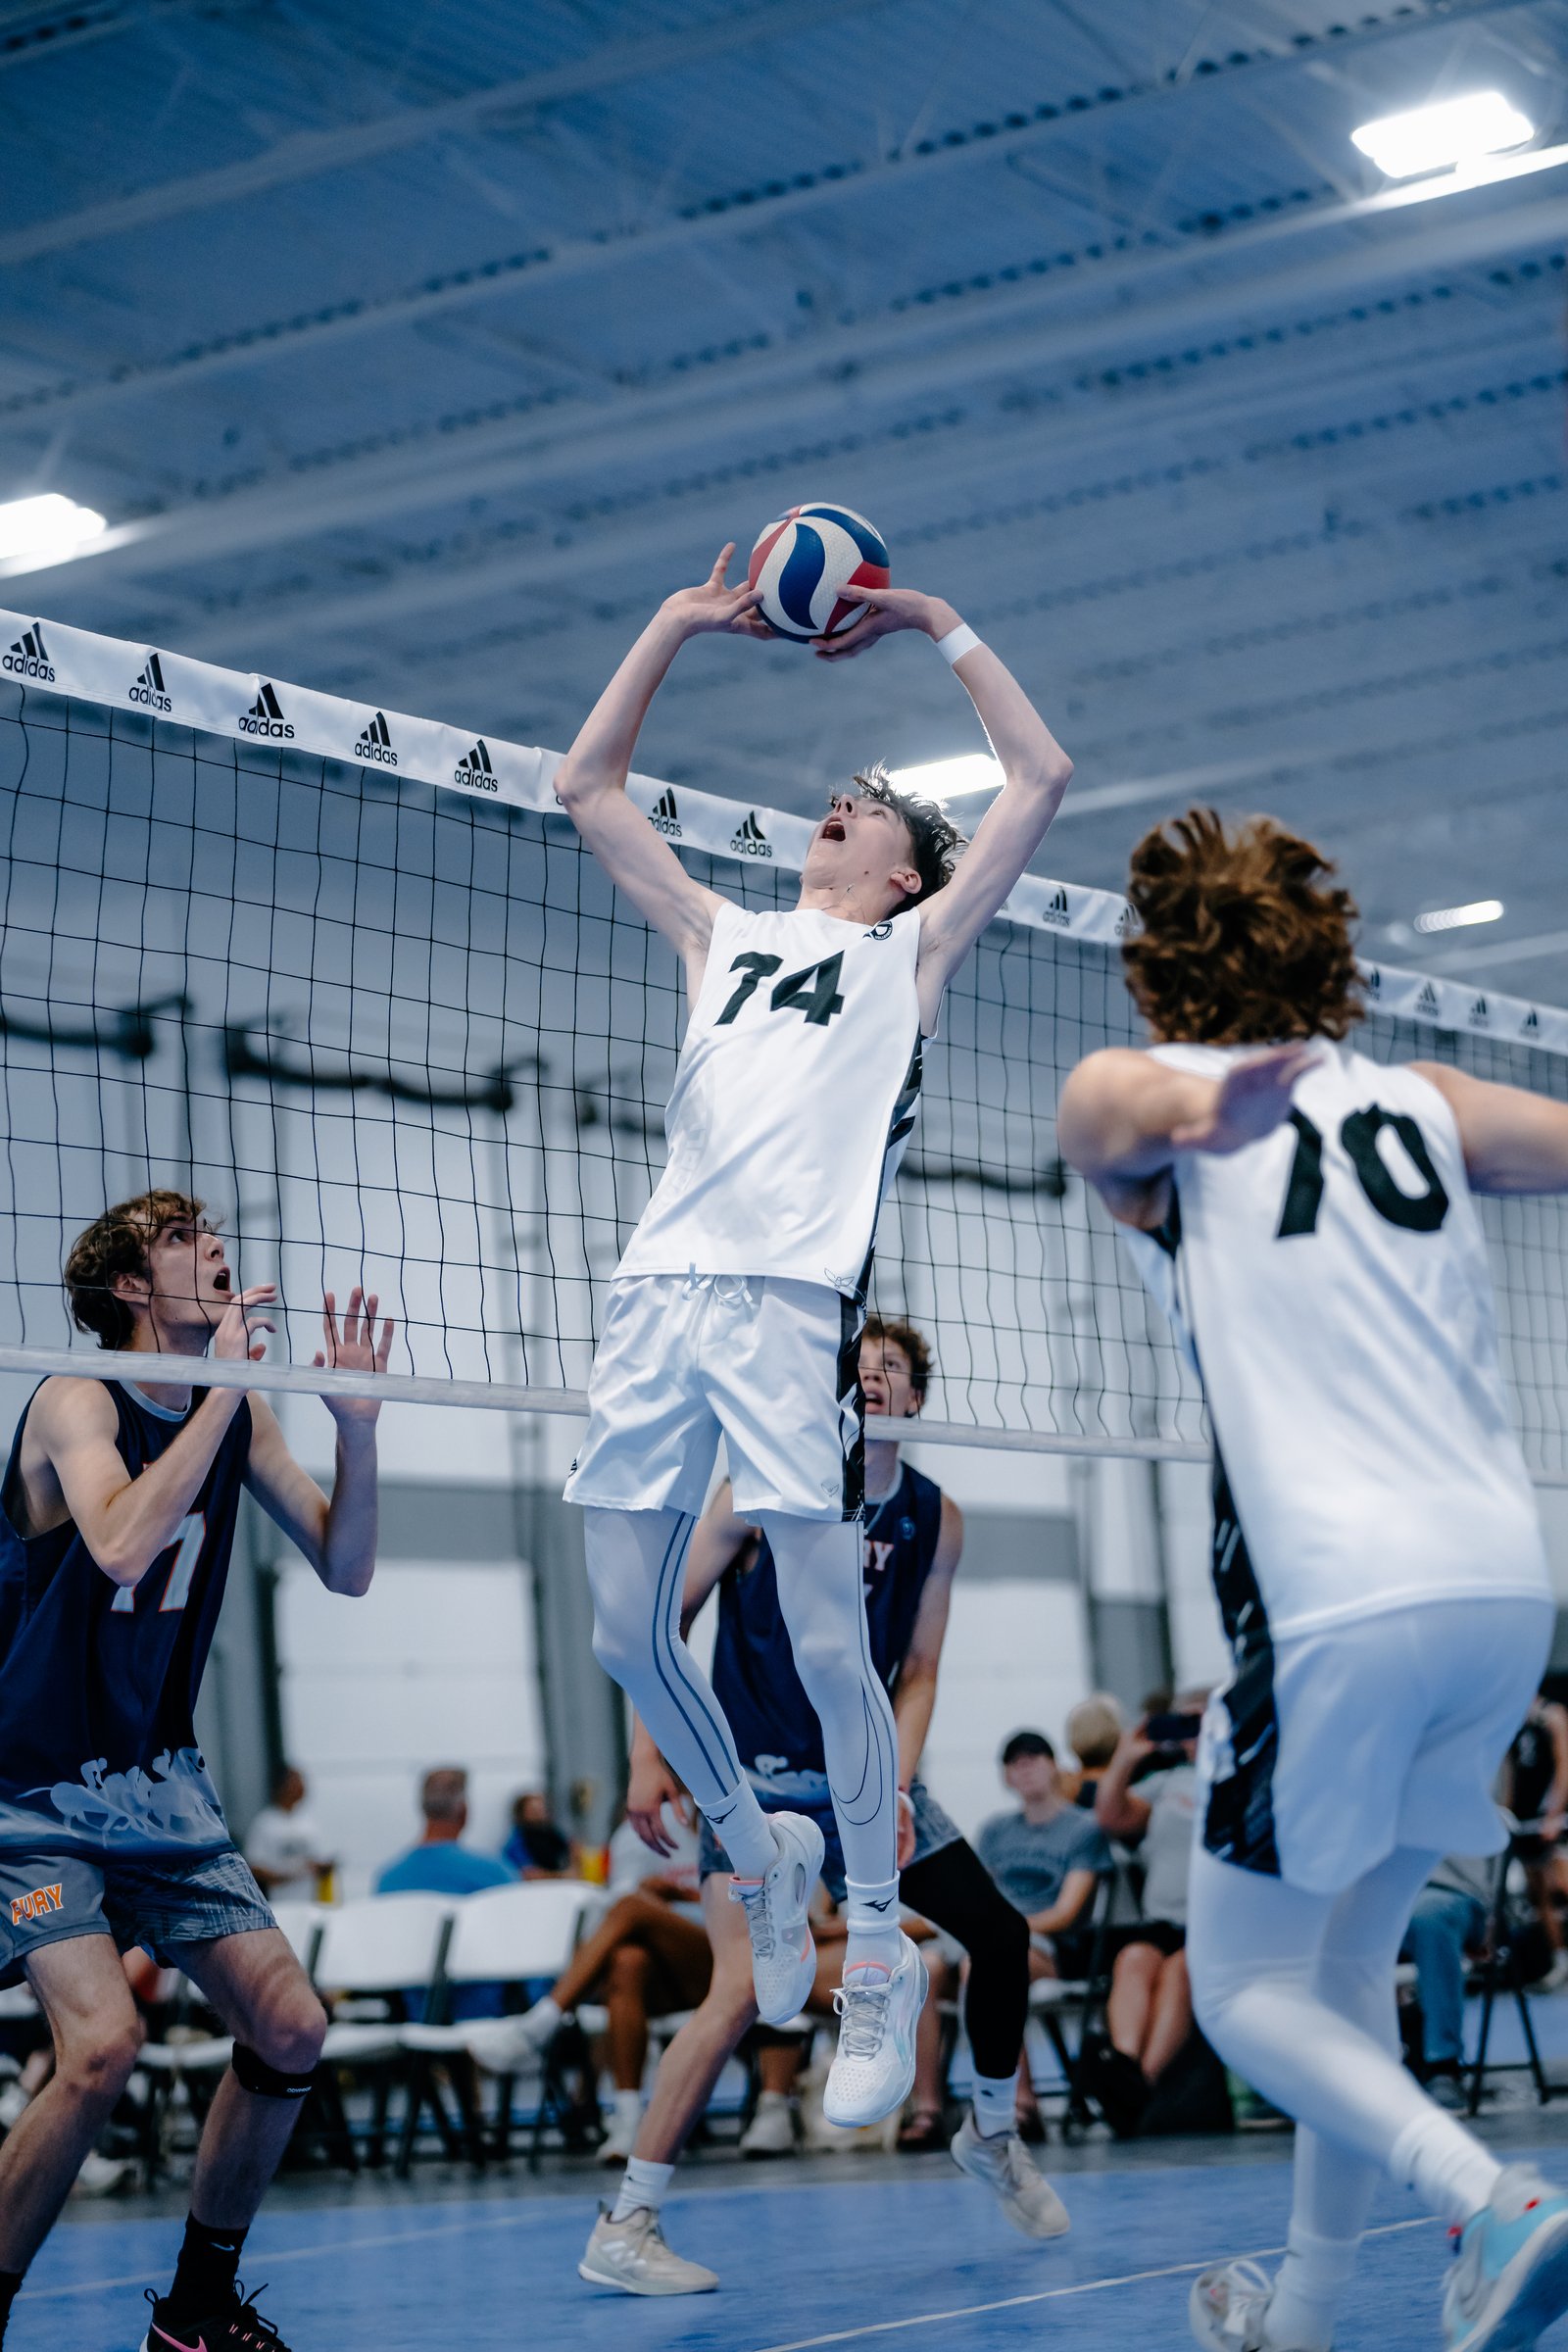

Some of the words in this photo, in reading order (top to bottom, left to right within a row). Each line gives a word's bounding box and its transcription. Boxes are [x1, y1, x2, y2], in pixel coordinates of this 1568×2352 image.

[2, 654, 56, 682] adidas
[128, 685, 172, 712] adidas
[238, 715, 295, 739] adidas
[354, 741, 398, 766] adidas
[454, 768, 499, 792] adidas
[729, 839, 773, 858] adidas
[10, 1883, 65, 1927] FURY
